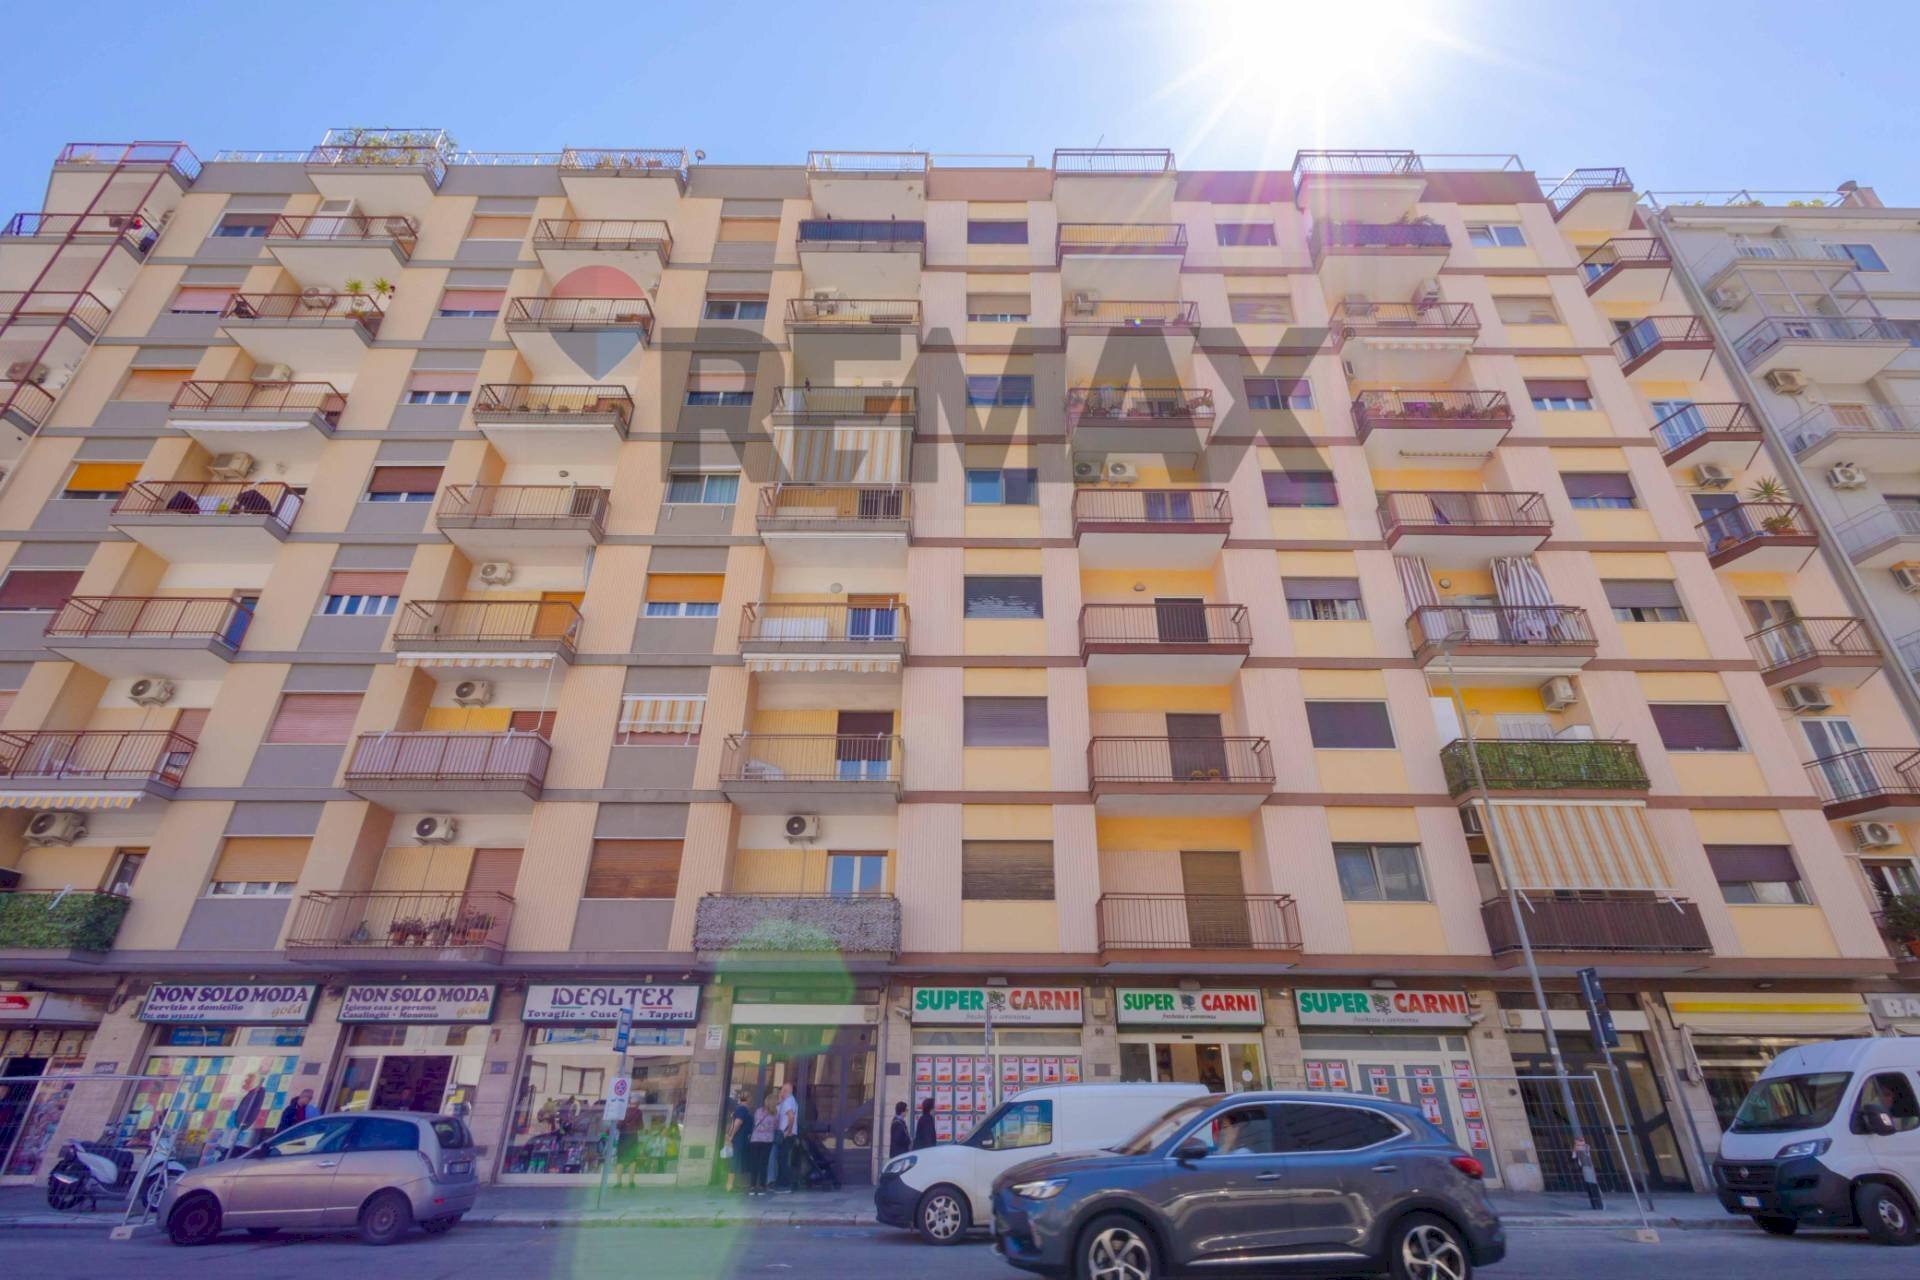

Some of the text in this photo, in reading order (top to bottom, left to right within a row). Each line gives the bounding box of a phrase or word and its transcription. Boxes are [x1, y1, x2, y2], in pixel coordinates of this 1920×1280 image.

[153, 987, 308, 1002] NON SOLO MODA
[348, 988, 489, 1002] NON SOLO MODA
[551, 987, 674, 1006] IDEALTEX
[915, 990, 1080, 1010] SUPER CARNI
[1123, 993, 1257, 1012] SUPER CARNI
[1300, 992, 1467, 1014] SUPER CARNI
[342, 1011, 389, 1019] Casalinghi
[528, 1010, 576, 1018] Tovaglie
[649, 1010, 693, 1019] Tappeti
